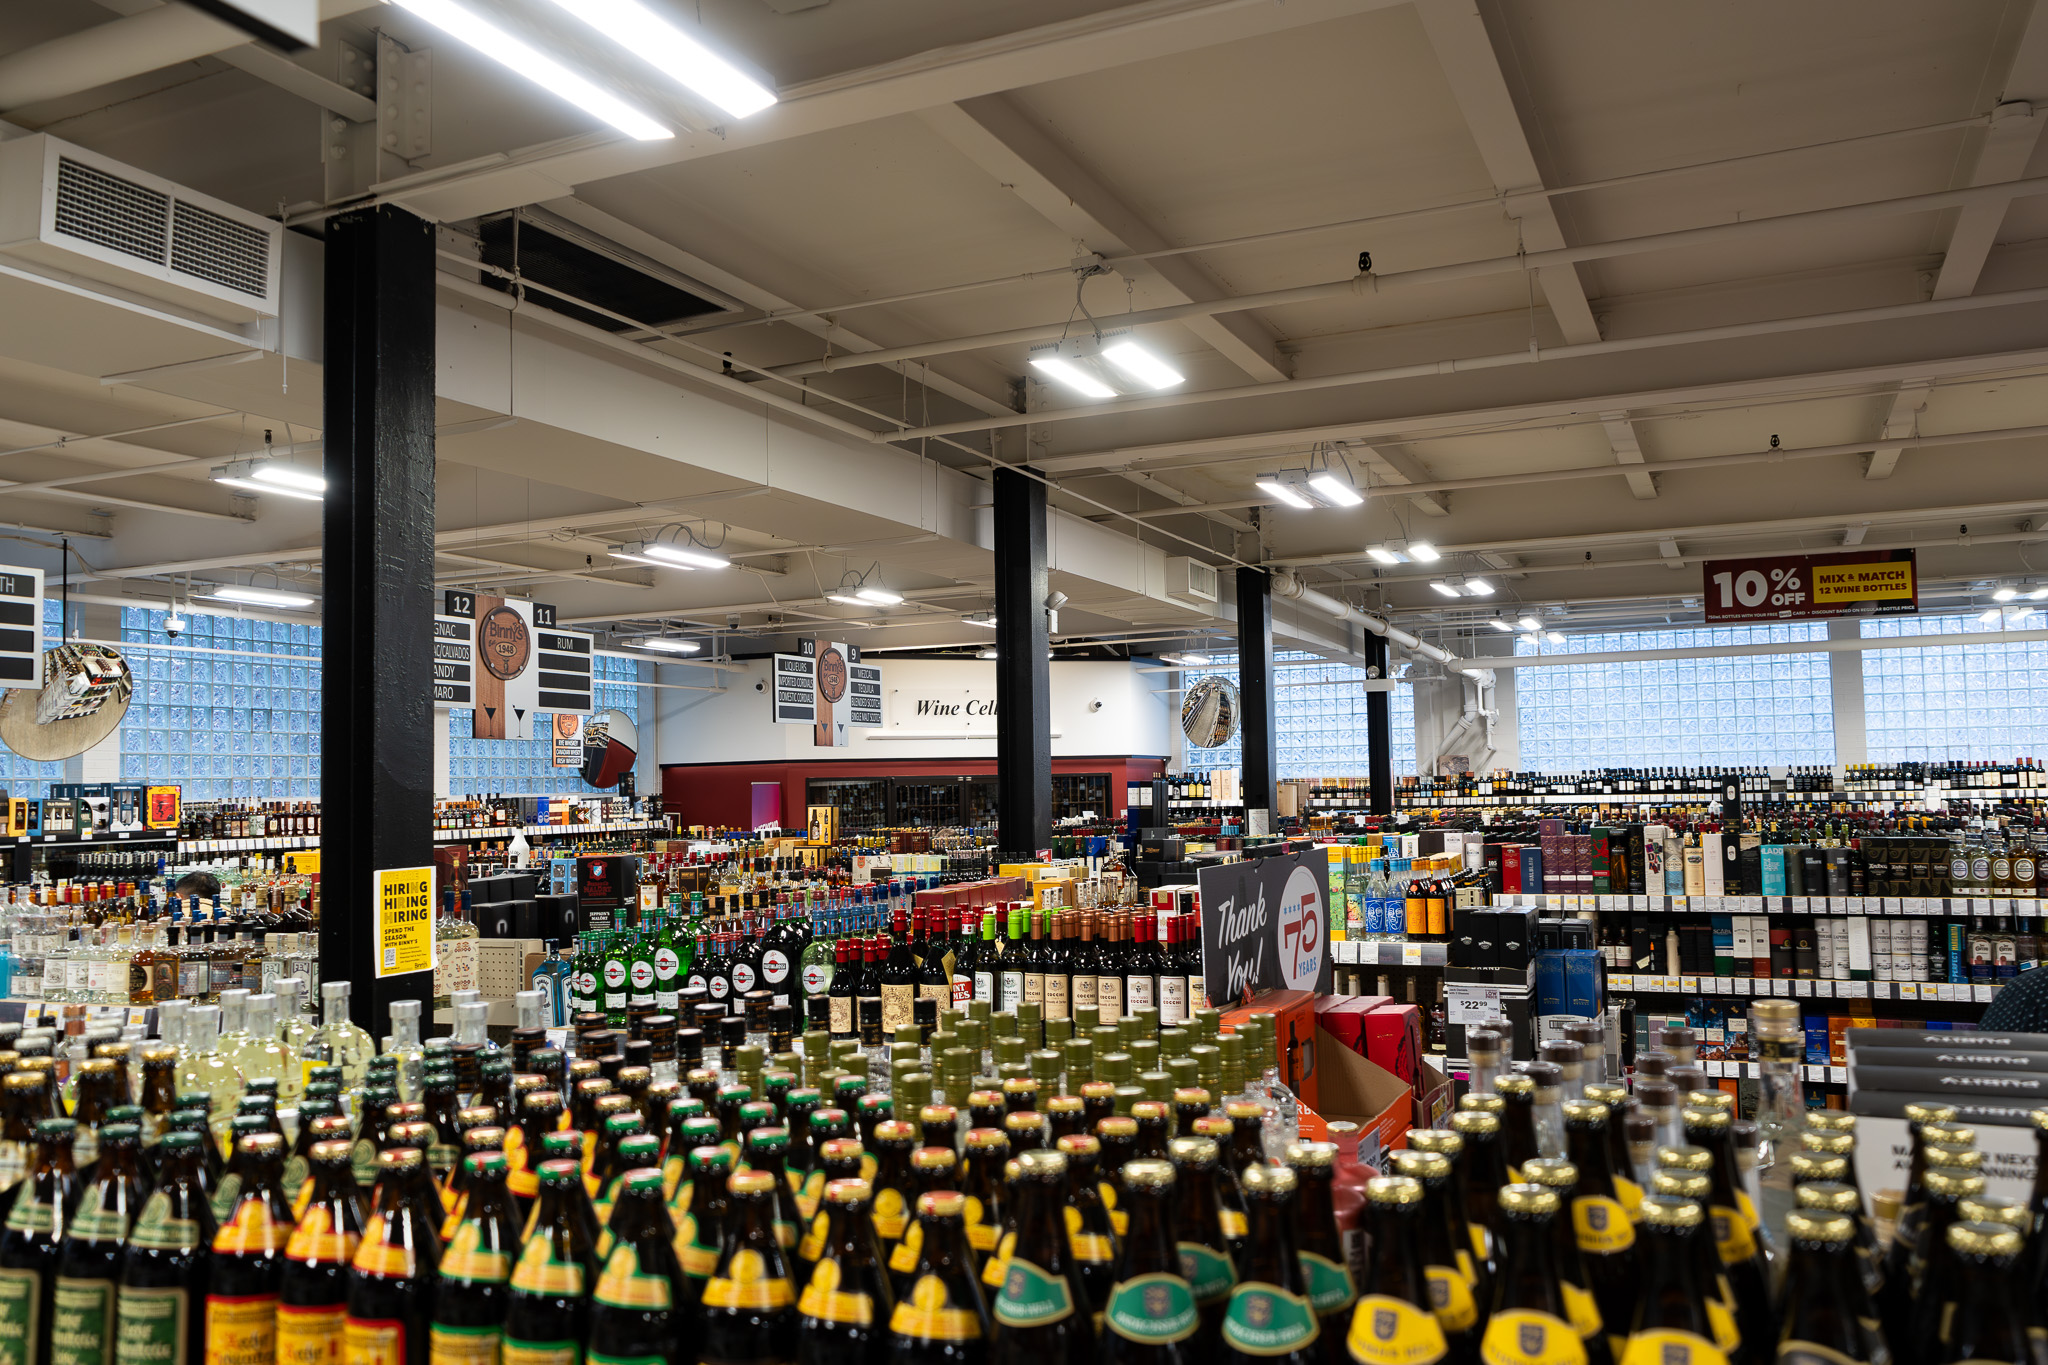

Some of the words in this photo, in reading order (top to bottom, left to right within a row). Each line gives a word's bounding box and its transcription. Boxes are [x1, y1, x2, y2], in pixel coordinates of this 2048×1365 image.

[1820, 574, 1845, 584] MIX
[1848, 573, 1856, 582] &
[1858, 570, 1904, 582] MATCH
[1819, 586, 1830, 595] 12
[1833, 585, 1860, 594] WINE
[1863, 582, 1908, 592] BOTTLES
[454, 596, 470, 614] 12
[1771, 592, 1806, 606] OFF
[537, 608, 552, 625] 11
[490, 622, 523, 642] Binny's
[498, 644, 514, 654] 1948
[557, 638, 573, 650] RUM
[804, 642, 813, 654] 10
[851, 649, 857, 660] 9
[785, 661, 807, 672] LIQUEURS
[858, 670, 873, 679] MEZCAL
[797, 678, 813, 689] CORDIALS
[858, 684, 874, 694] TEQUILA
[779, 691, 797, 702] DOMESTIC
[797, 692, 813, 703] CORDIALS
[852, 697, 867, 707] BLENDED
[917, 700, 960, 716] Wine
[384, 881, 427, 896] HIRING
[384, 895, 427, 910] HIRING
[384, 909, 427, 924] HIRING
[1218, 882, 1267, 949] Thank
[1284, 892, 1317, 980] 75
[1228, 937, 1263, 1001] You!
[1298, 957, 1316, 977] YEARS
